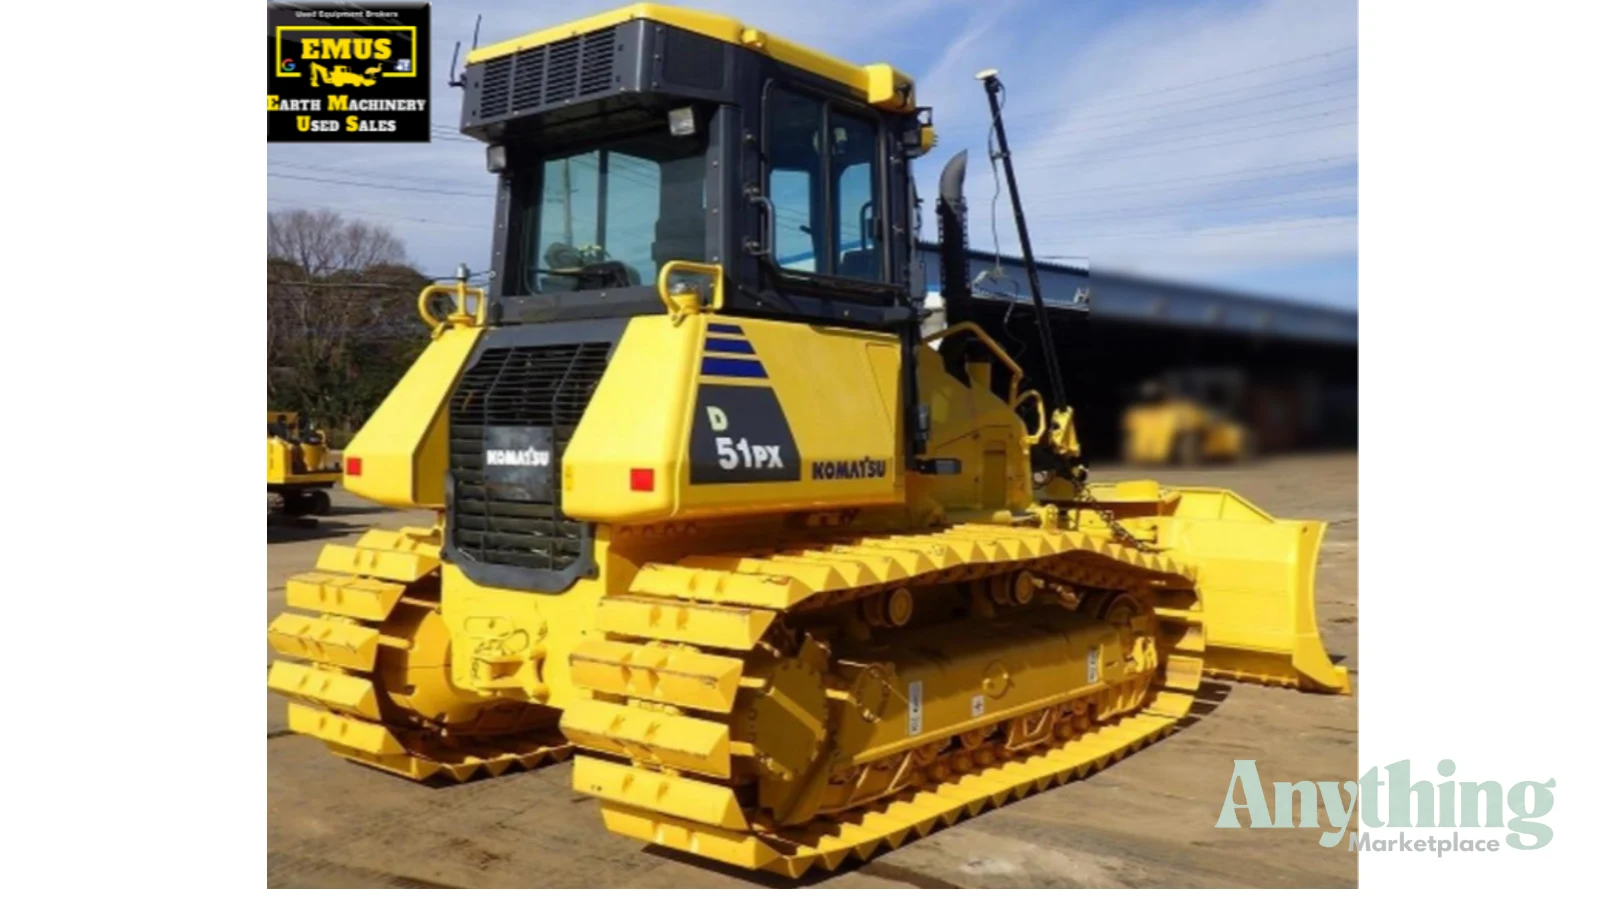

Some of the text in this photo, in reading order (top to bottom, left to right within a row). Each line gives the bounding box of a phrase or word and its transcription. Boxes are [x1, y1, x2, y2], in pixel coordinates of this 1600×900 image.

[706, 405, 728, 432] D
[486, 446, 550, 467] KOMATSU
[715, 436, 784, 470] 51PX
[811, 456, 886, 480] KOMATSU
